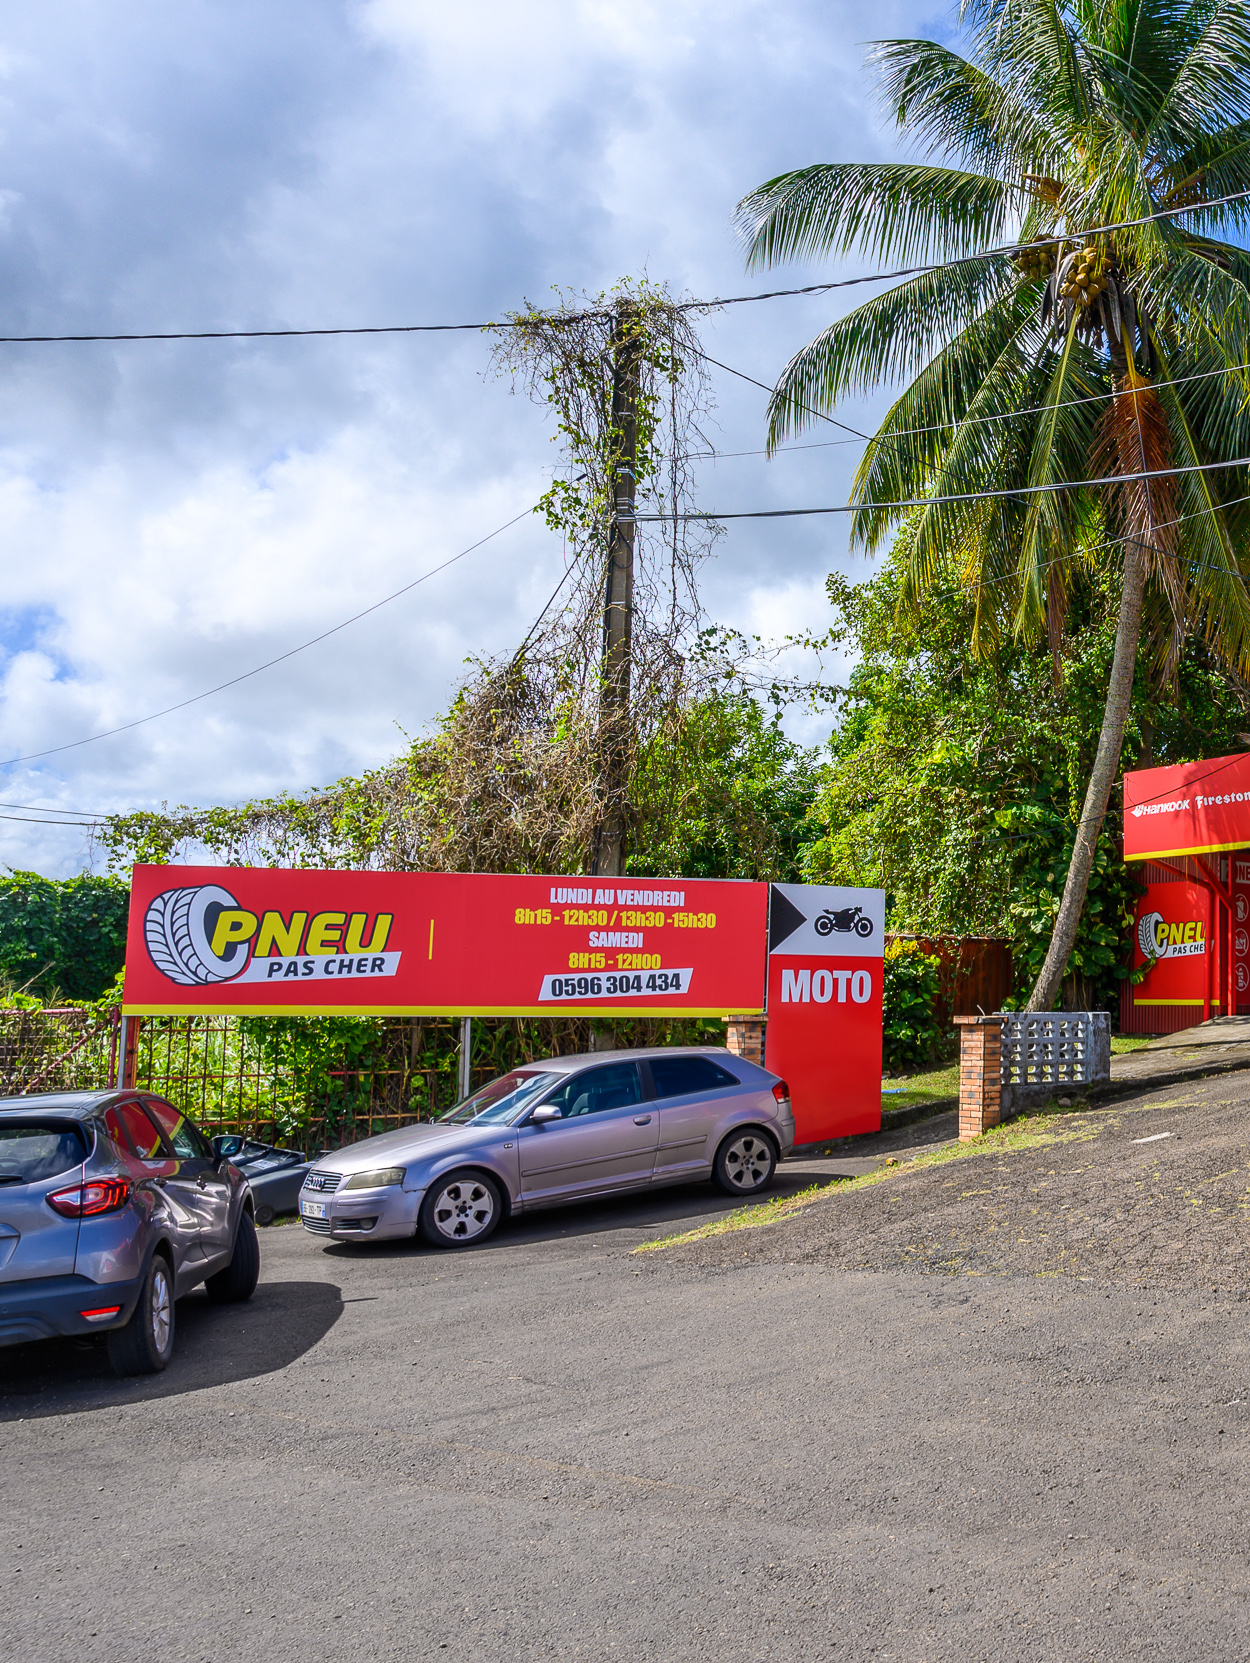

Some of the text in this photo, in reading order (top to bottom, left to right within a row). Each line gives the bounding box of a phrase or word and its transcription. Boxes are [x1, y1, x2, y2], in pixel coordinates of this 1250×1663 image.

[550, 887, 685, 907] LUNDI AU VENDREDI
[514, 908, 552, 925] 8h15
[562, 909, 608, 926] 12h30
[610, 911, 618, 926] /
[619, 910, 665, 927] 13h30
[210, 909, 394, 958] PNEU
[588, 930, 644, 948] SAMEDI
[1172, 943, 1206, 956] PAS CHE
[267, 957, 386, 978] PAS CHER
[568, 952, 606, 969] 8H15
[615, 953, 662, 970] 12H00
[551, 972, 682, 997] 0596 304 434
[780, 969, 872, 1004] MOTO
